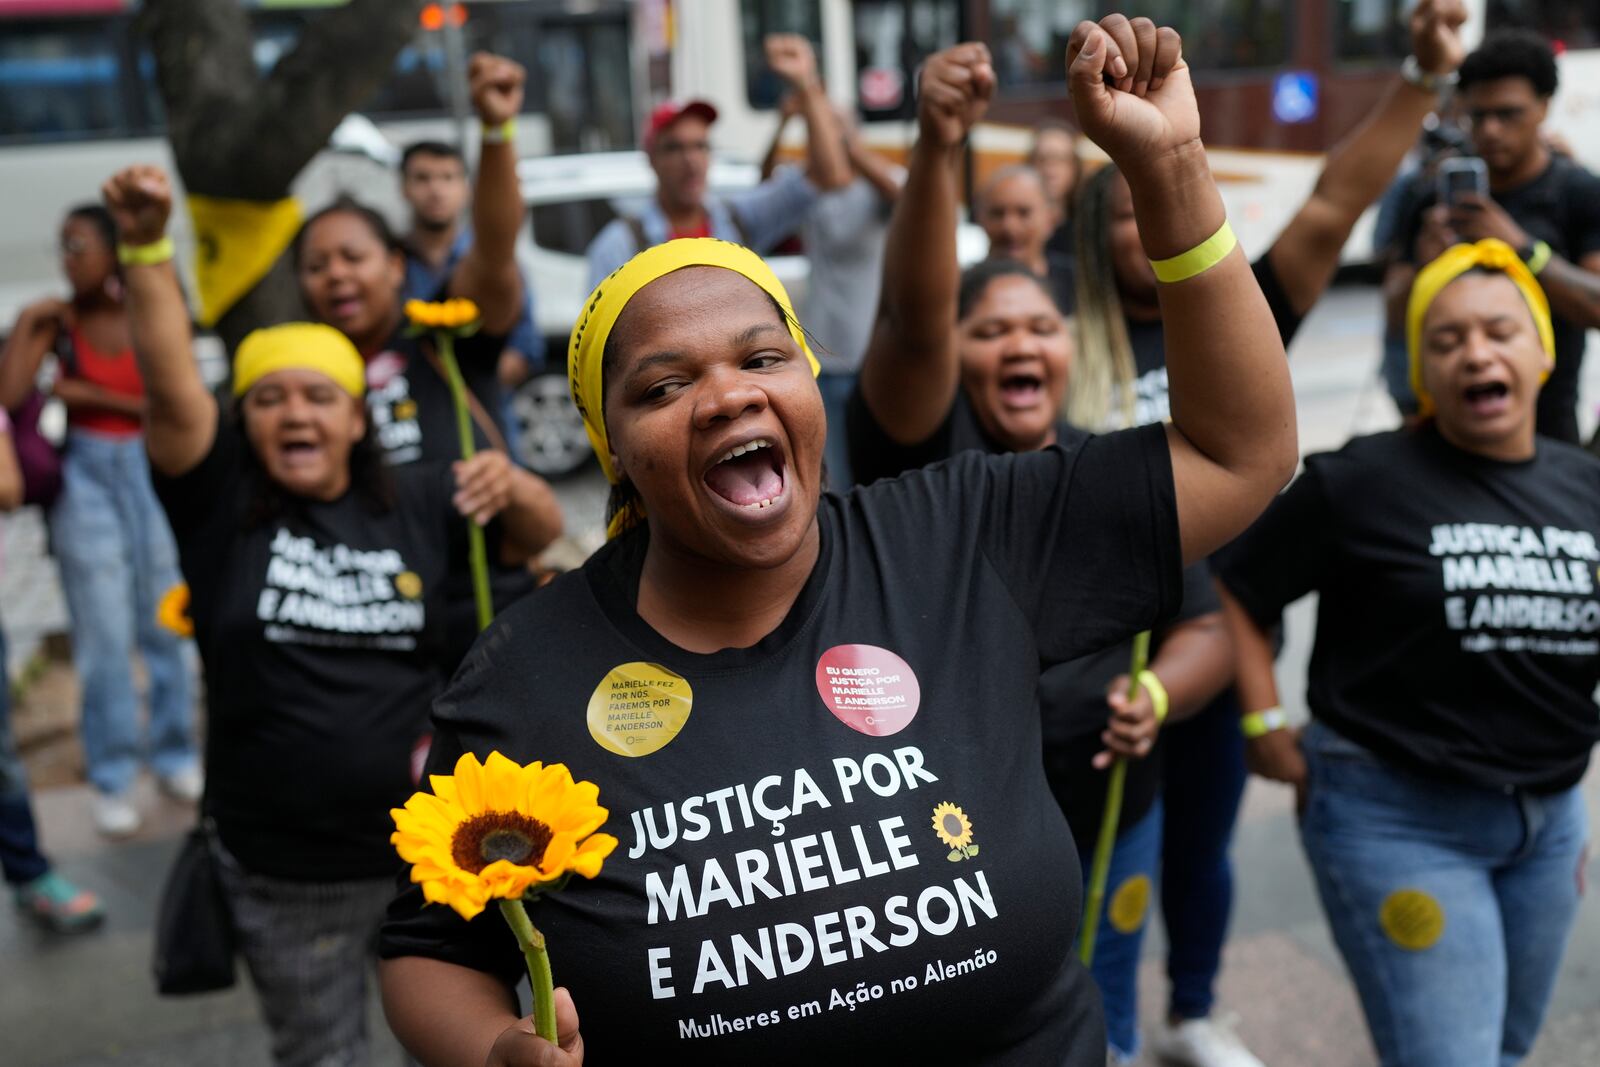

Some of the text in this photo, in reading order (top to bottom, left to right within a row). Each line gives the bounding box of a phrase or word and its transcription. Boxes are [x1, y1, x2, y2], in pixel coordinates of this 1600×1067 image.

[1429, 523, 1600, 561] JUSTIÇA POR
[1442, 555, 1593, 595] MARIELLE
[1445, 597, 1467, 630] E
[826, 667, 880, 676] EU QUERO
[611, 680, 655, 690] MARIELLE
[829, 674, 901, 687] JUSTIÇA POR
[610, 693, 628, 701] POR
[832, 687, 885, 695] MARIELLE
[609, 699, 671, 711] FAREMOS POR
[844, 695, 906, 705] ANDERSON
[607, 711, 653, 721] MARIELLE
[606, 720, 664, 732] E ANDERSON
[628, 745, 940, 859] JUSTIÇA POR
[645, 815, 920, 925] MARIELLE
[647, 870, 999, 1000] E ANDERSON
[678, 947, 998, 1040] Mulheres em Ação no Alemão
